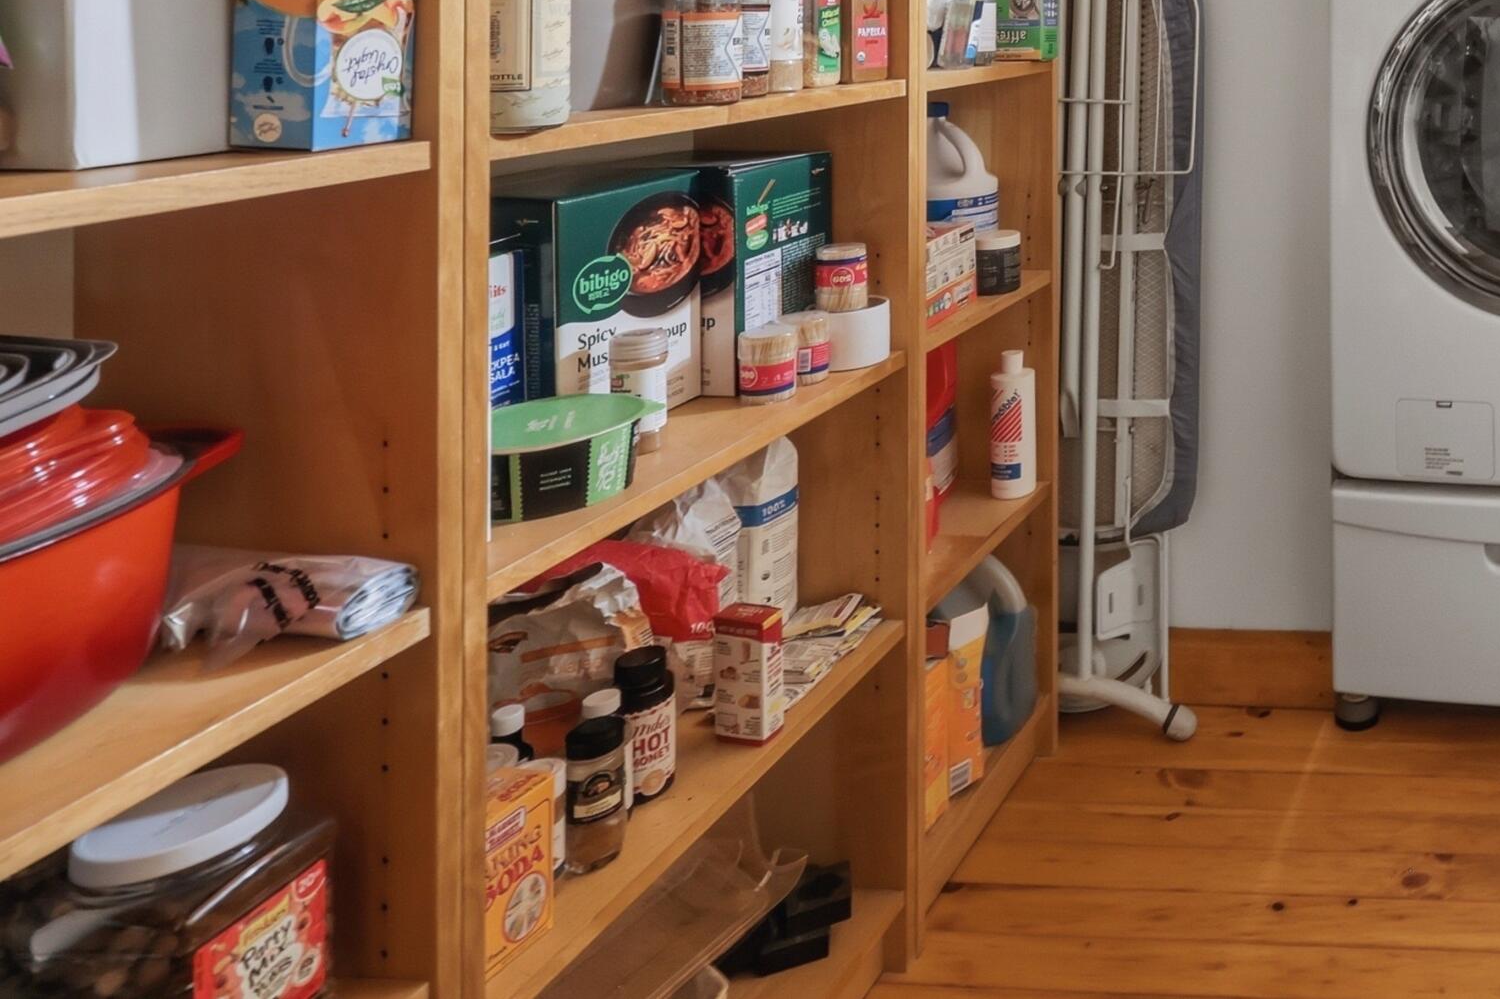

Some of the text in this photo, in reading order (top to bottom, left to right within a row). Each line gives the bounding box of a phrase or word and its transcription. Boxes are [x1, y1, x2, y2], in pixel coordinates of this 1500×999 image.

[857, 26, 887, 38] PAPRIKA
[996, 29, 1027, 44] affre
[578, 268, 629, 295] bibigo
[700, 316, 717, 334] up
[577, 325, 617, 351] Spicy
[490, 366, 516, 384] SALA
[633, 725, 671, 758] HOT
[240, 918, 293, 971] Party
